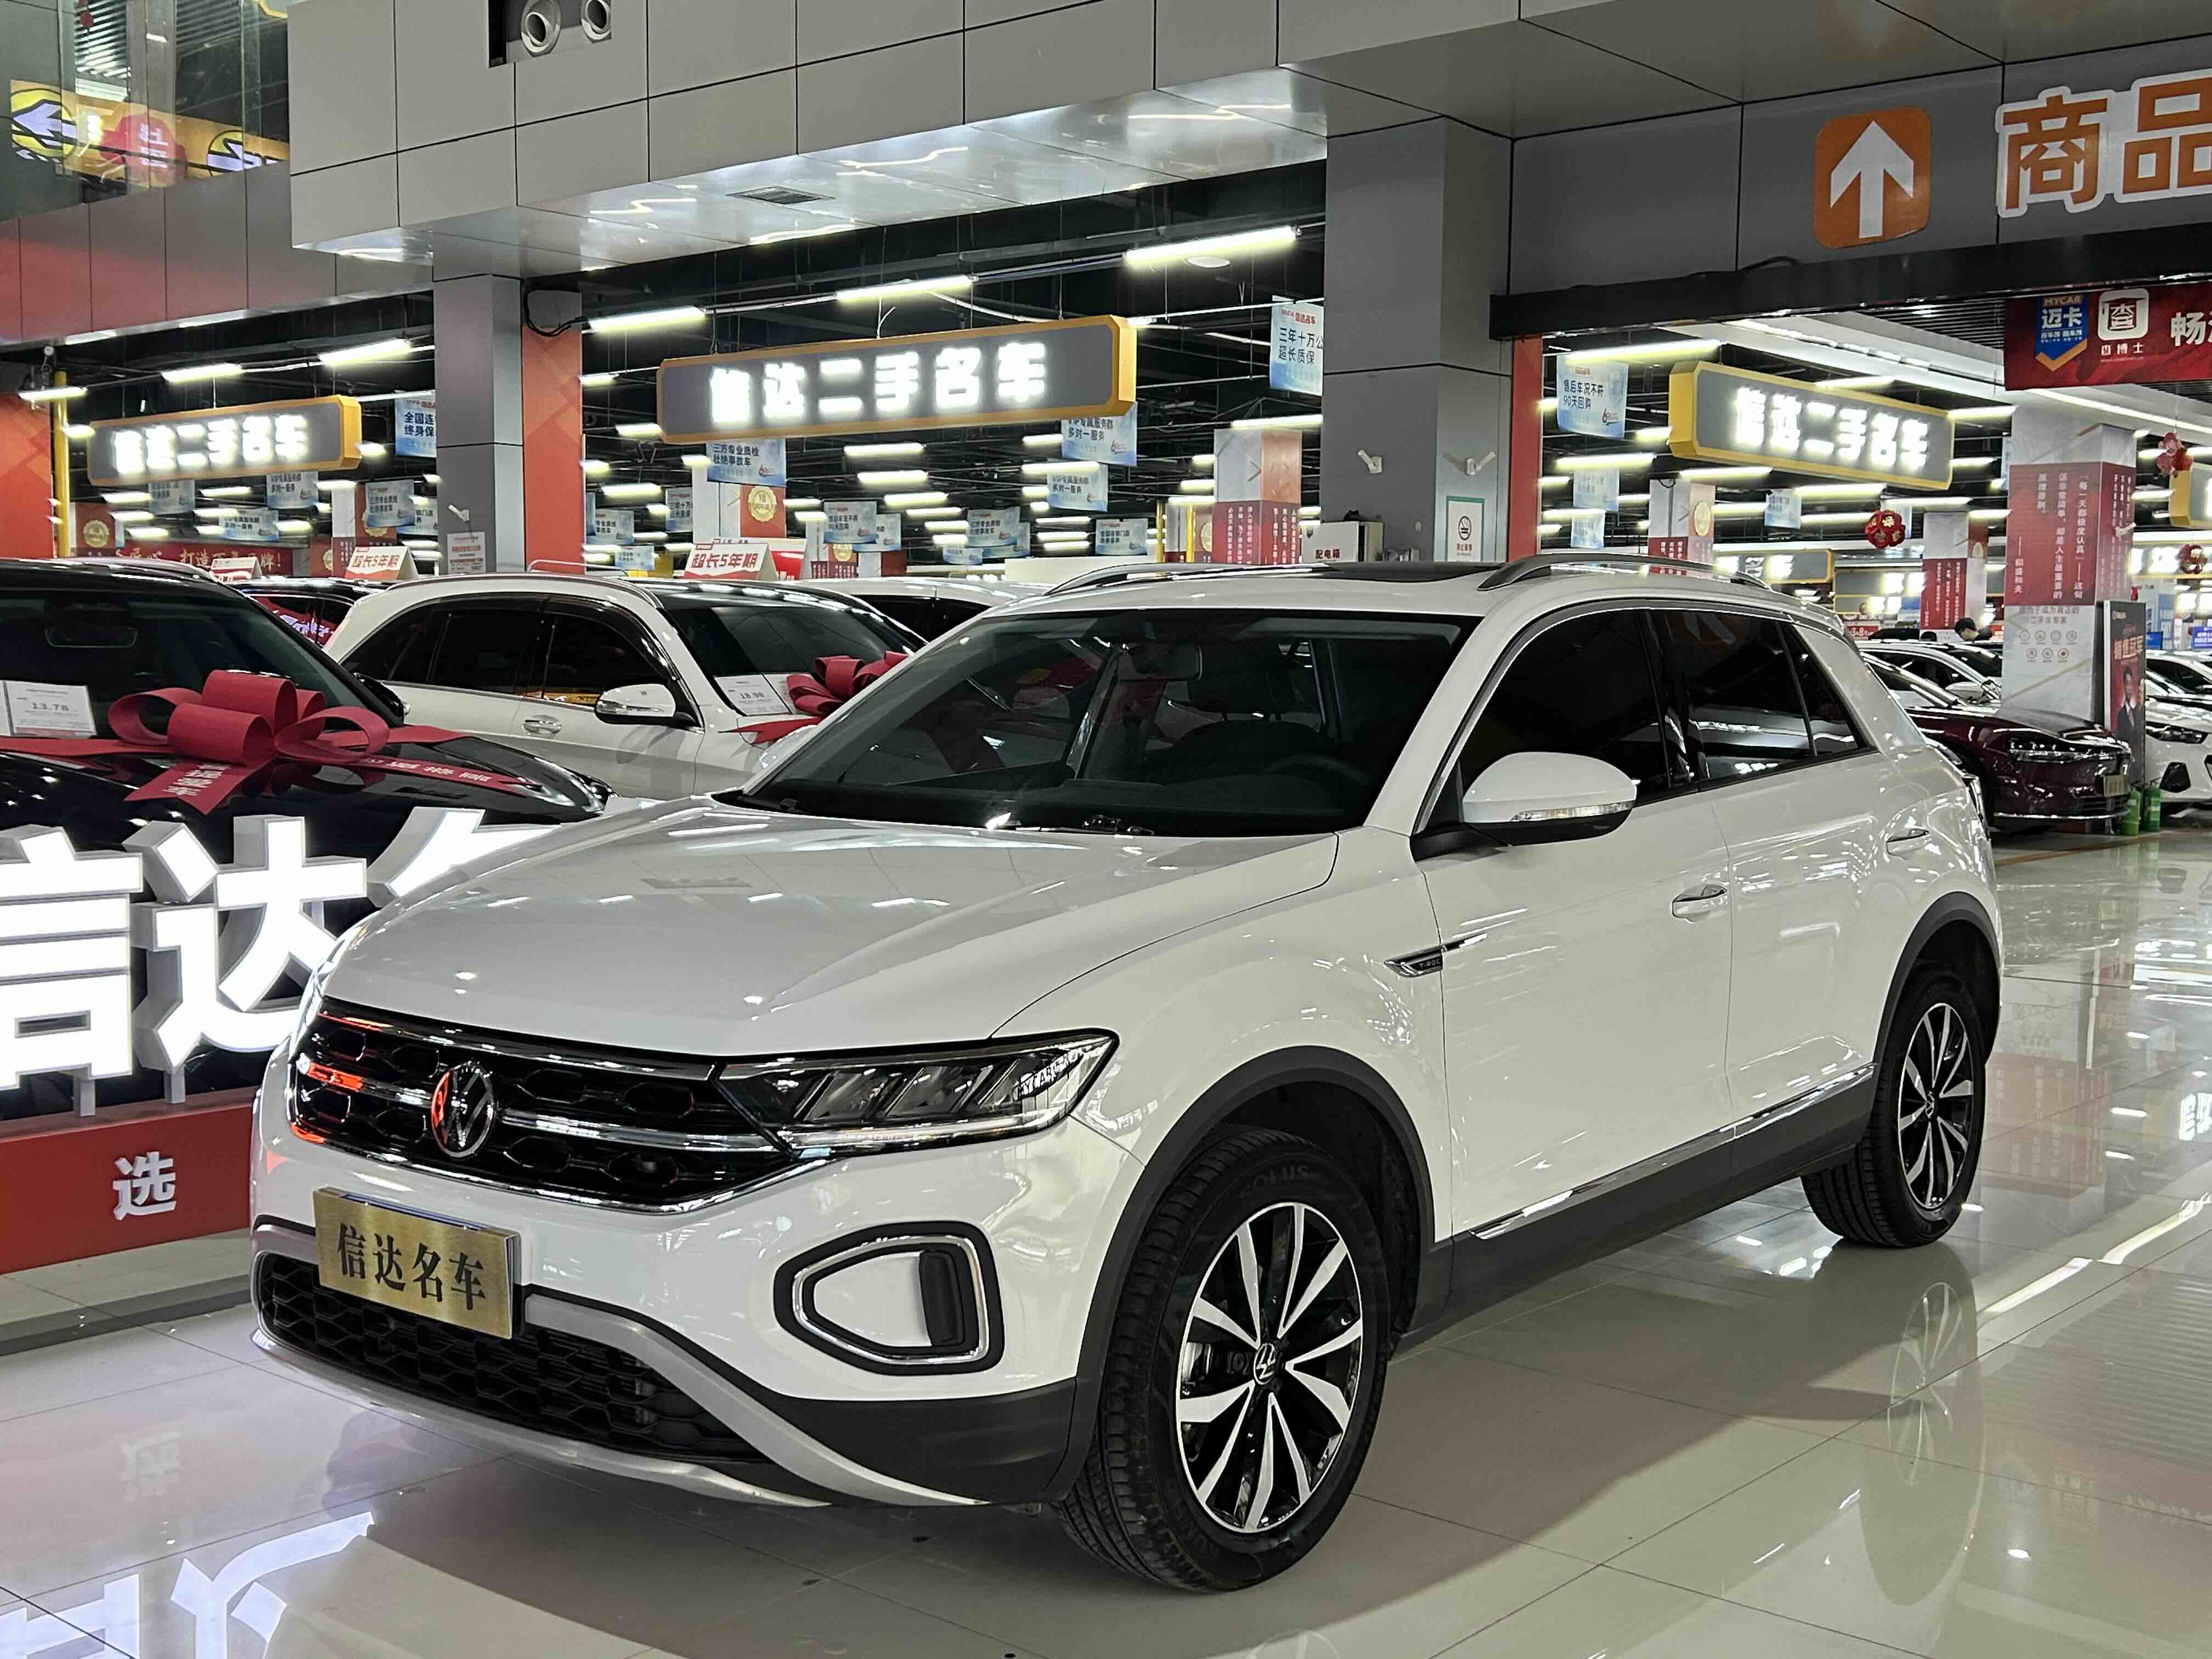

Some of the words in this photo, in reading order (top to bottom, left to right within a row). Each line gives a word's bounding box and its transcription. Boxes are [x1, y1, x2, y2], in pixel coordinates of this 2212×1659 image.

[1999, 74, 2212, 213] 商品
[2041, 307, 2083, 329] 迈卡
[2171, 312, 2212, 347] 畅
[1278, 345, 1315, 365] 超长质保
[2101, 342, 2144, 356] 查博士
[1563, 378, 1604, 397] 售后车况不符
[1563, 394, 1592, 410] 90天回购
[1316, 549, 1340, 559] 配电箱
[32, 702, 70, 712] 13.78
[0, 806, 561, 1091] 信达
[112, 1150, 177, 1220] 选
[336, 1222, 486, 1311] 信达名车
